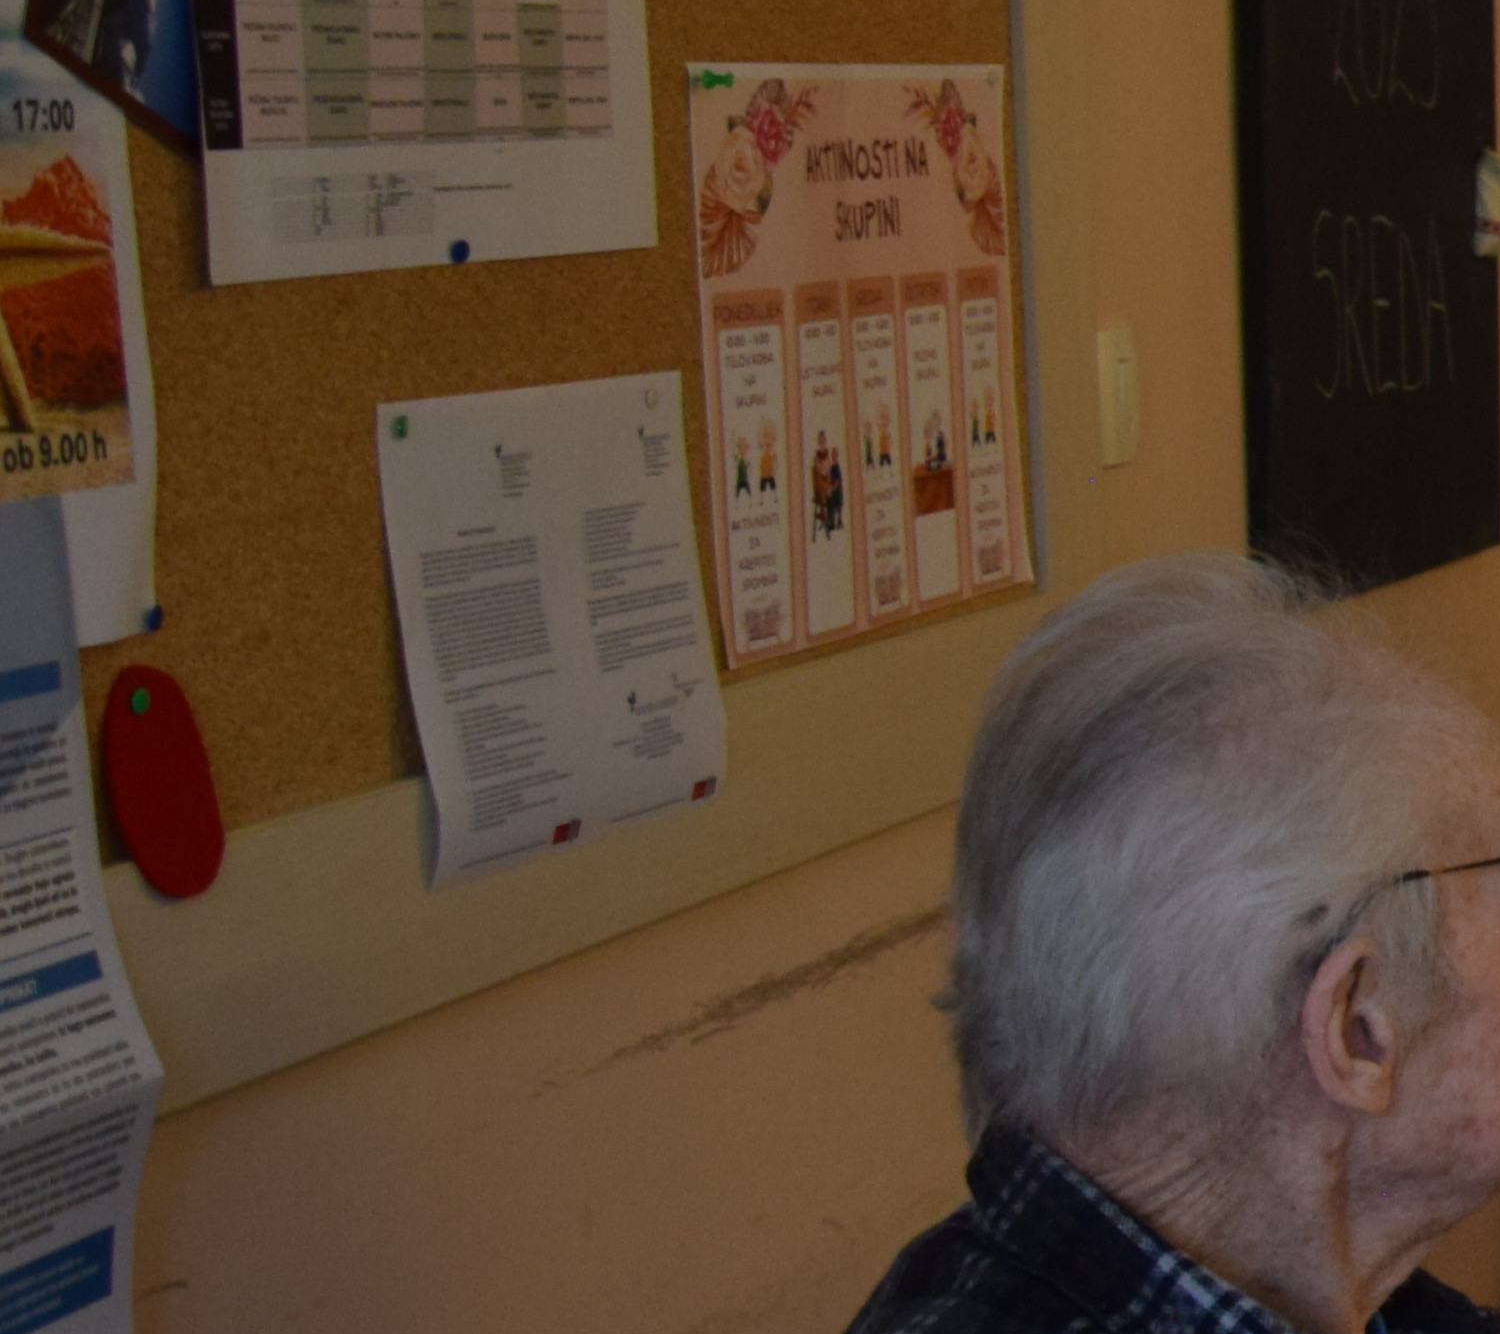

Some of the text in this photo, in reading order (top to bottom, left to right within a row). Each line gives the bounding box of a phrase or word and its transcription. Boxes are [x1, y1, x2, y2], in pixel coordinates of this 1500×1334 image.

[12, 98, 75, 132] 17:00
[904, 136, 930, 178] NA
[835, 196, 901, 242] SKUPINI
[1312, 208, 1456, 399] SREDA
[3, 428, 107, 473] ob 9.00 h
